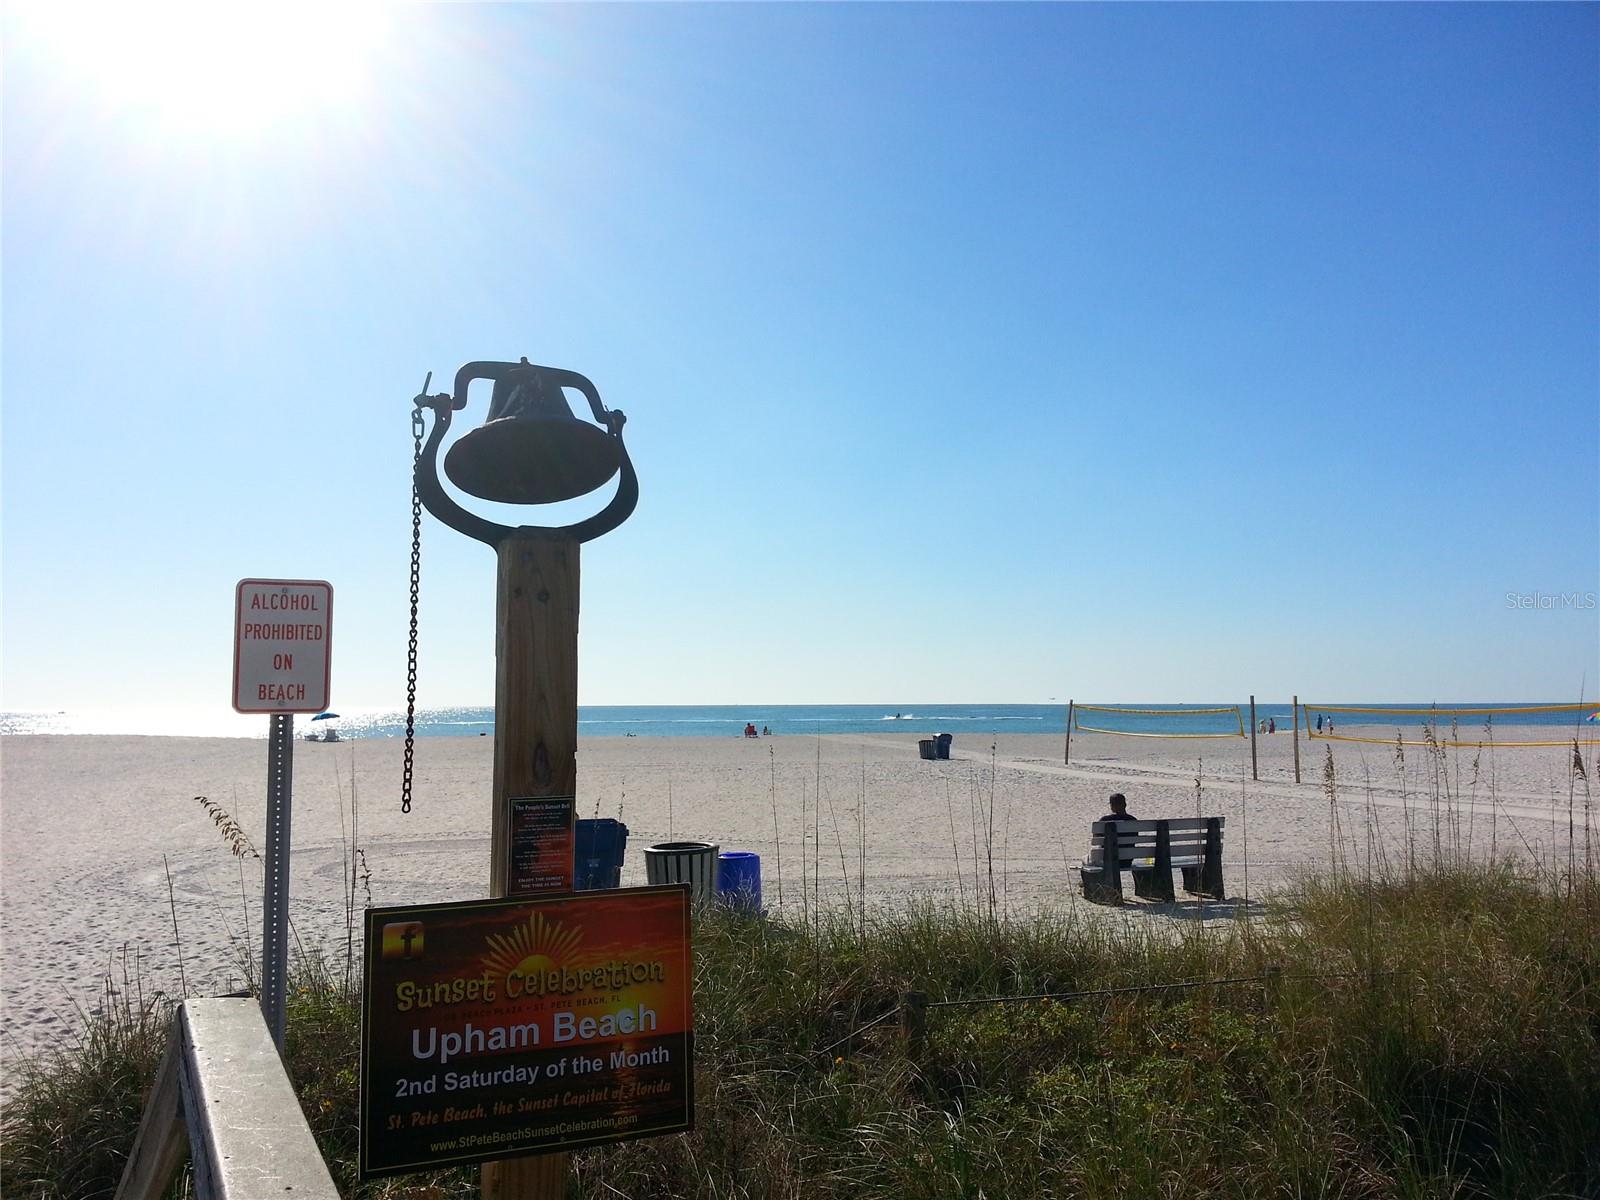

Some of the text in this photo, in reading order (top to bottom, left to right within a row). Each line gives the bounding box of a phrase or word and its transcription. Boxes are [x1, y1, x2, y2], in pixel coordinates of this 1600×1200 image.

[251, 593, 319, 611] ALCOHOL
[244, 623, 323, 640] PROHIBITED
[273, 653, 293, 670] ON
[258, 683, 305, 700] BEACH
[395, 960, 665, 1012] Sunset Celebration
[412, 1003, 657, 1064] Upham Beach
[395, 1046, 670, 1098] 2nd Saturday of the Month
[386, 1079, 672, 1131] St. Pete Beach, the Sunset Capital of Florida
[429, 1113, 638, 1153] www.StPeteBeachSunsetCelebration.com
